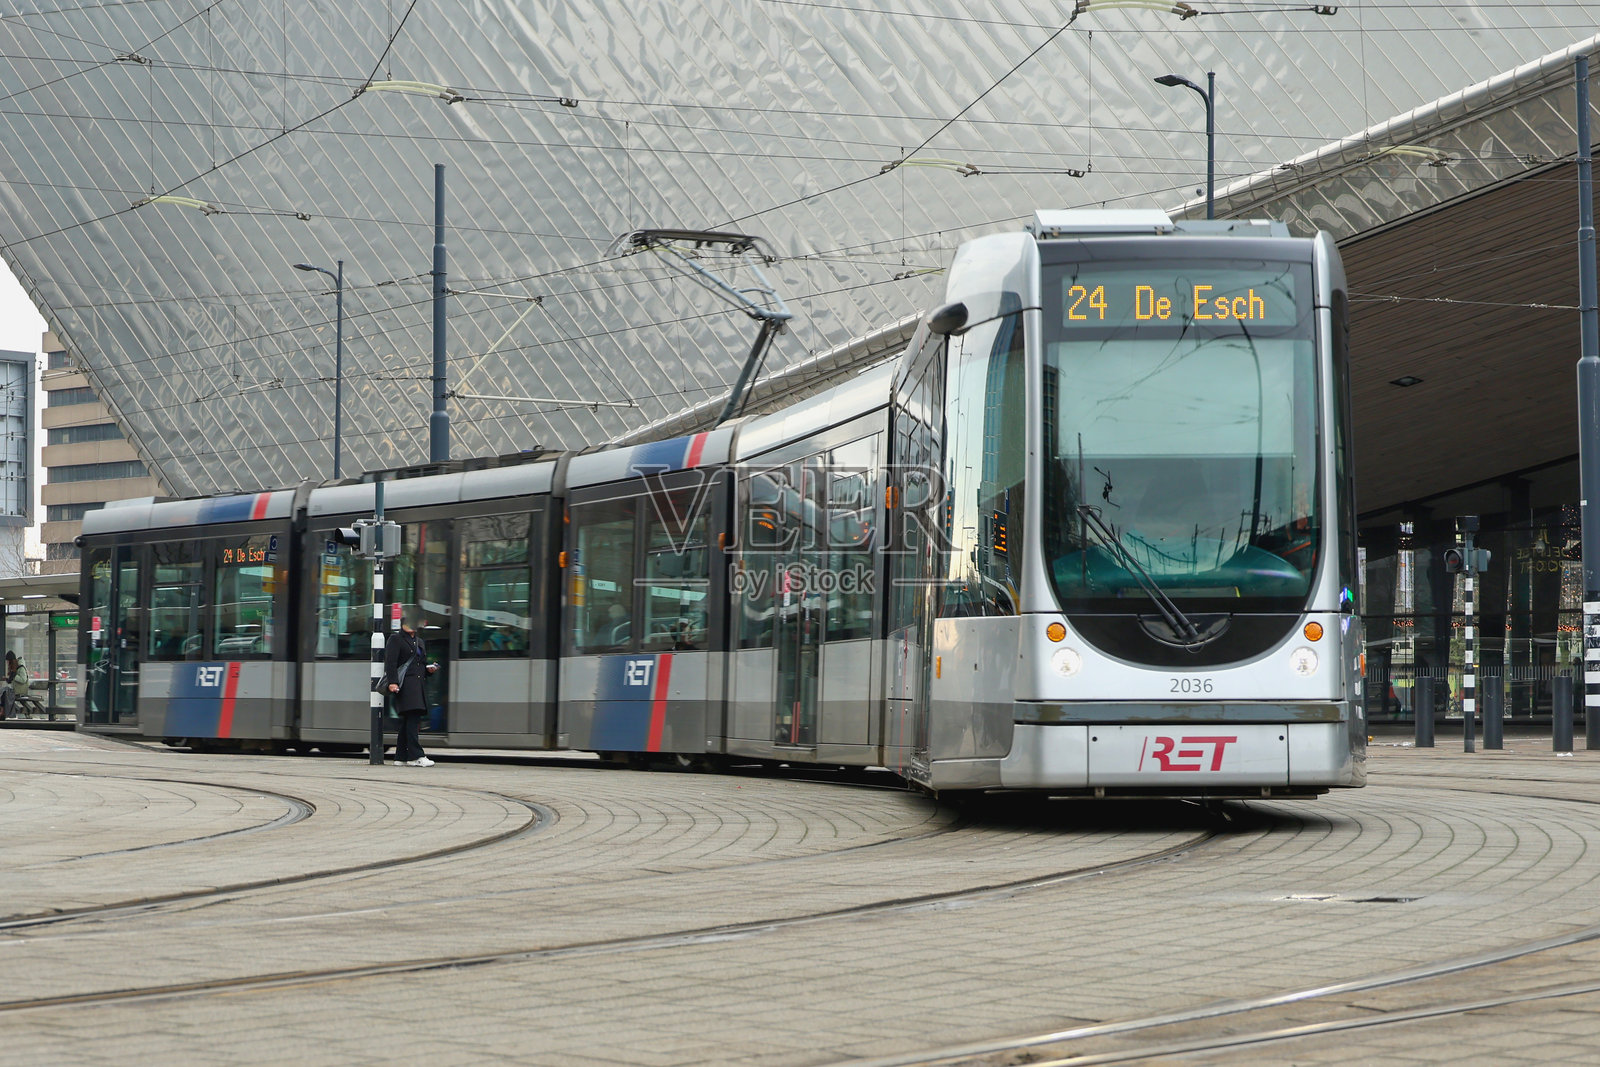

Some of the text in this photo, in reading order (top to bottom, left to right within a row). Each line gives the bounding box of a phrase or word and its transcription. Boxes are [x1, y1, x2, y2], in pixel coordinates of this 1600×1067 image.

[1068, 285, 1266, 320] 24 De Esch
[224, 549, 233, 564] 24
[237, 548, 246, 563] De
[198, 667, 223, 687] RET
[624, 660, 653, 686] RET
[1170, 678, 1213, 693] 2036
[1151, 736, 1238, 772] RET
